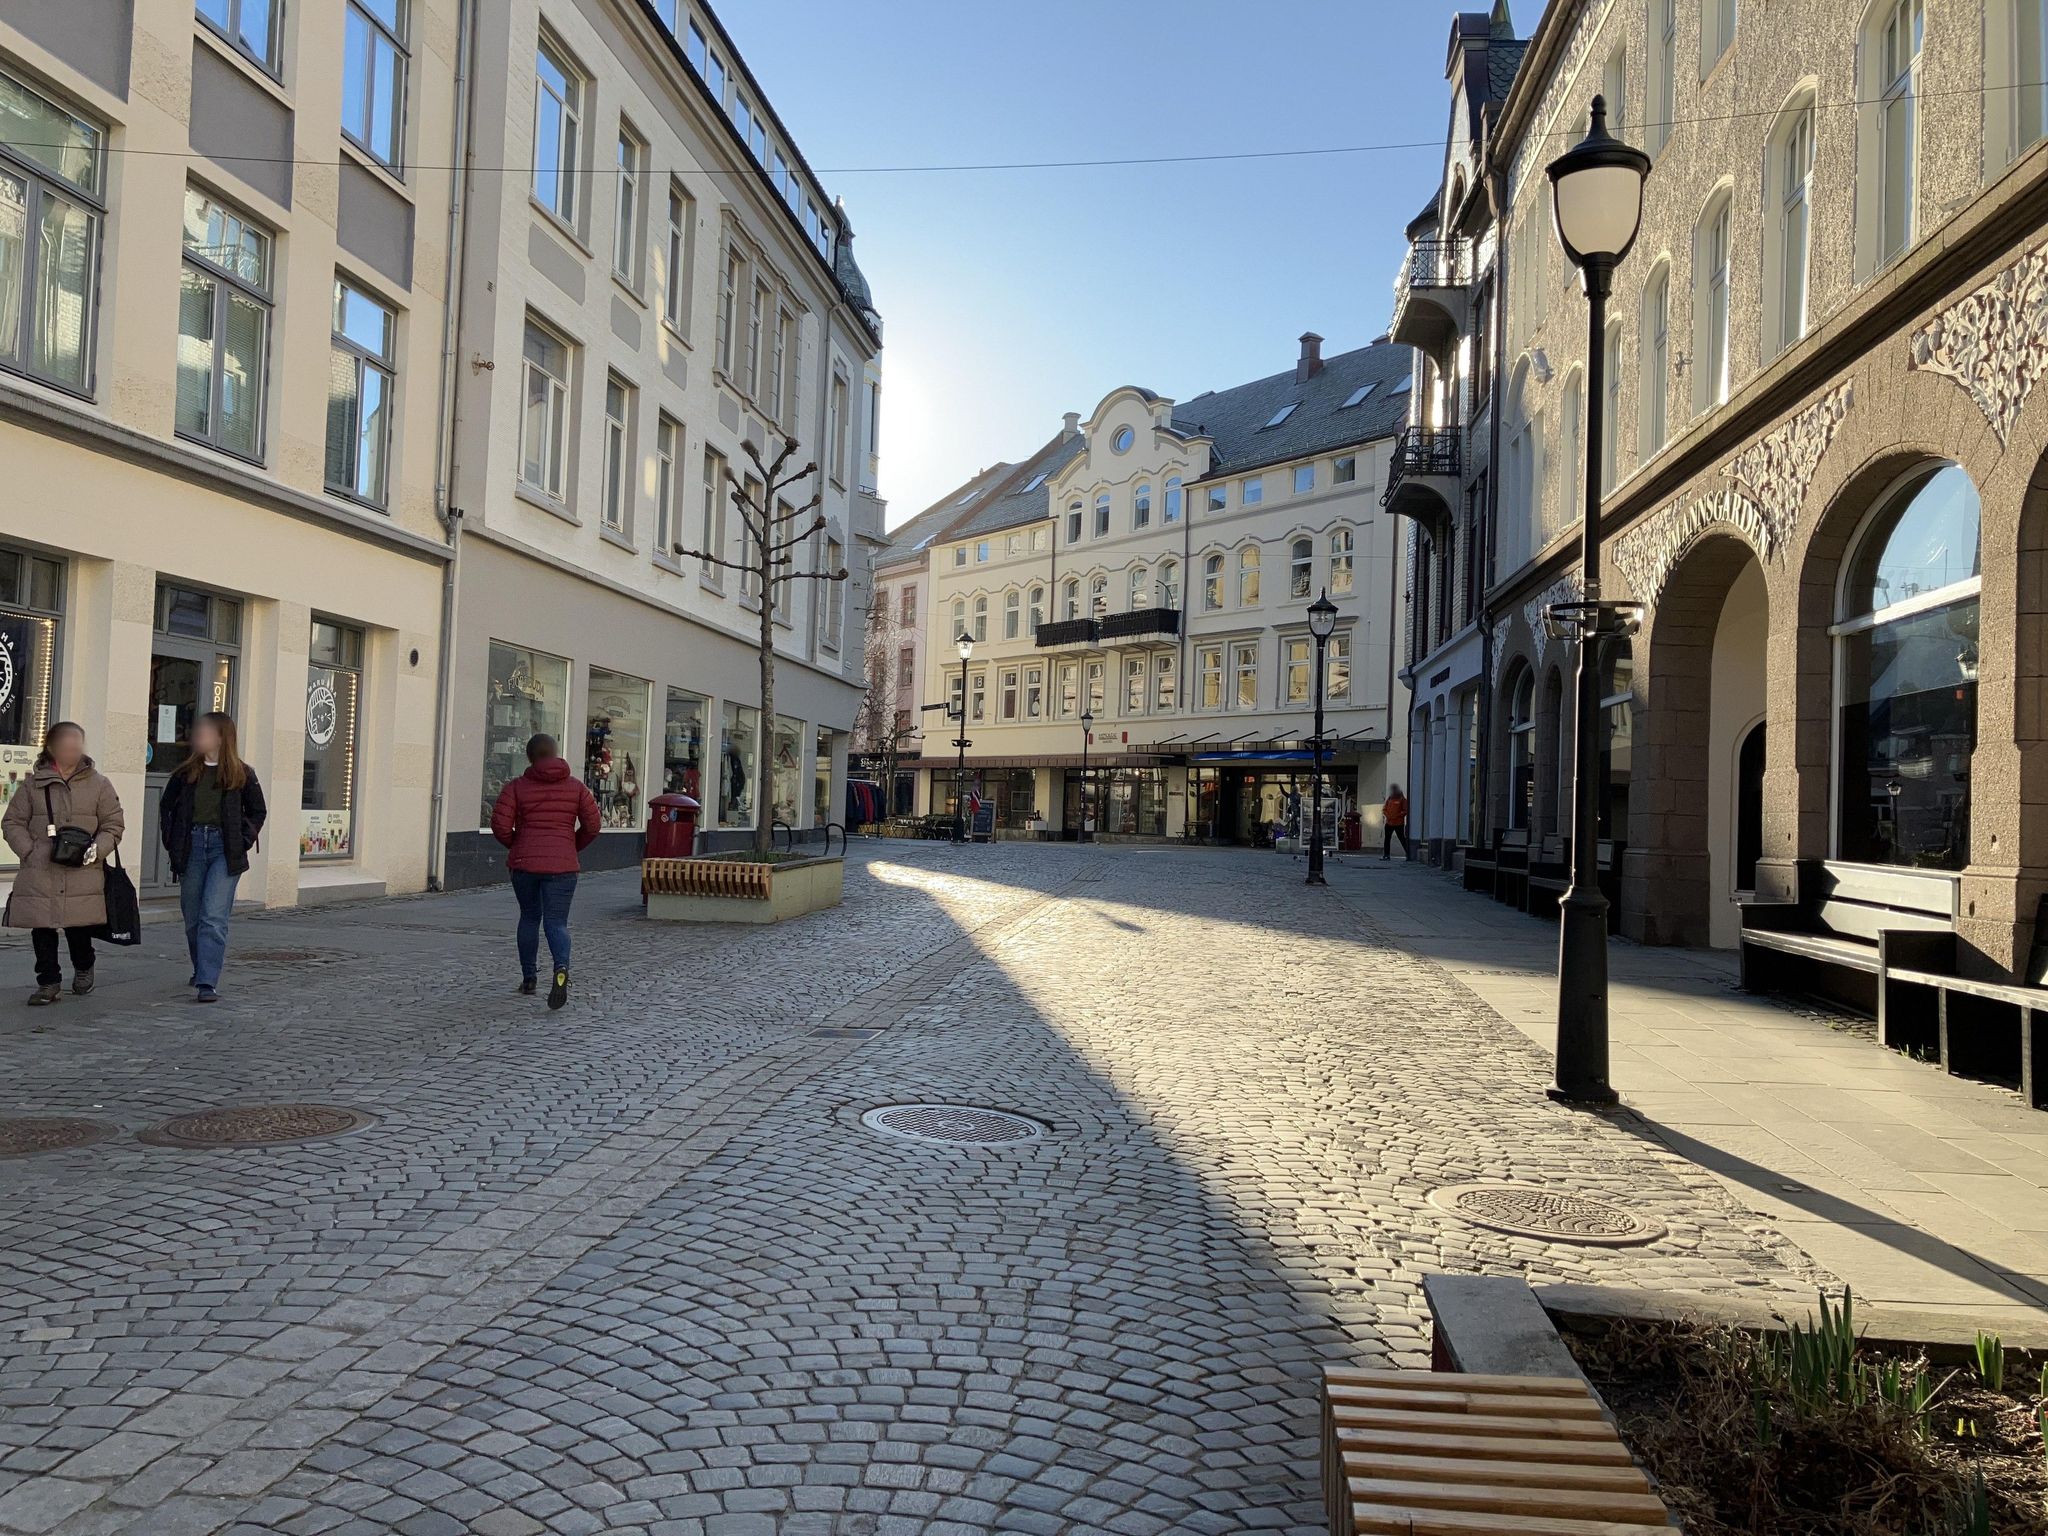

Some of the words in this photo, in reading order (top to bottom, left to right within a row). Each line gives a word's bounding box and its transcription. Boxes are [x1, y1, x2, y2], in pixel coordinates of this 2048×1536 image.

[308, 679, 325, 694] MARU
[1, 693, 16, 714] MORE
[213, 685, 222, 712] OPE
